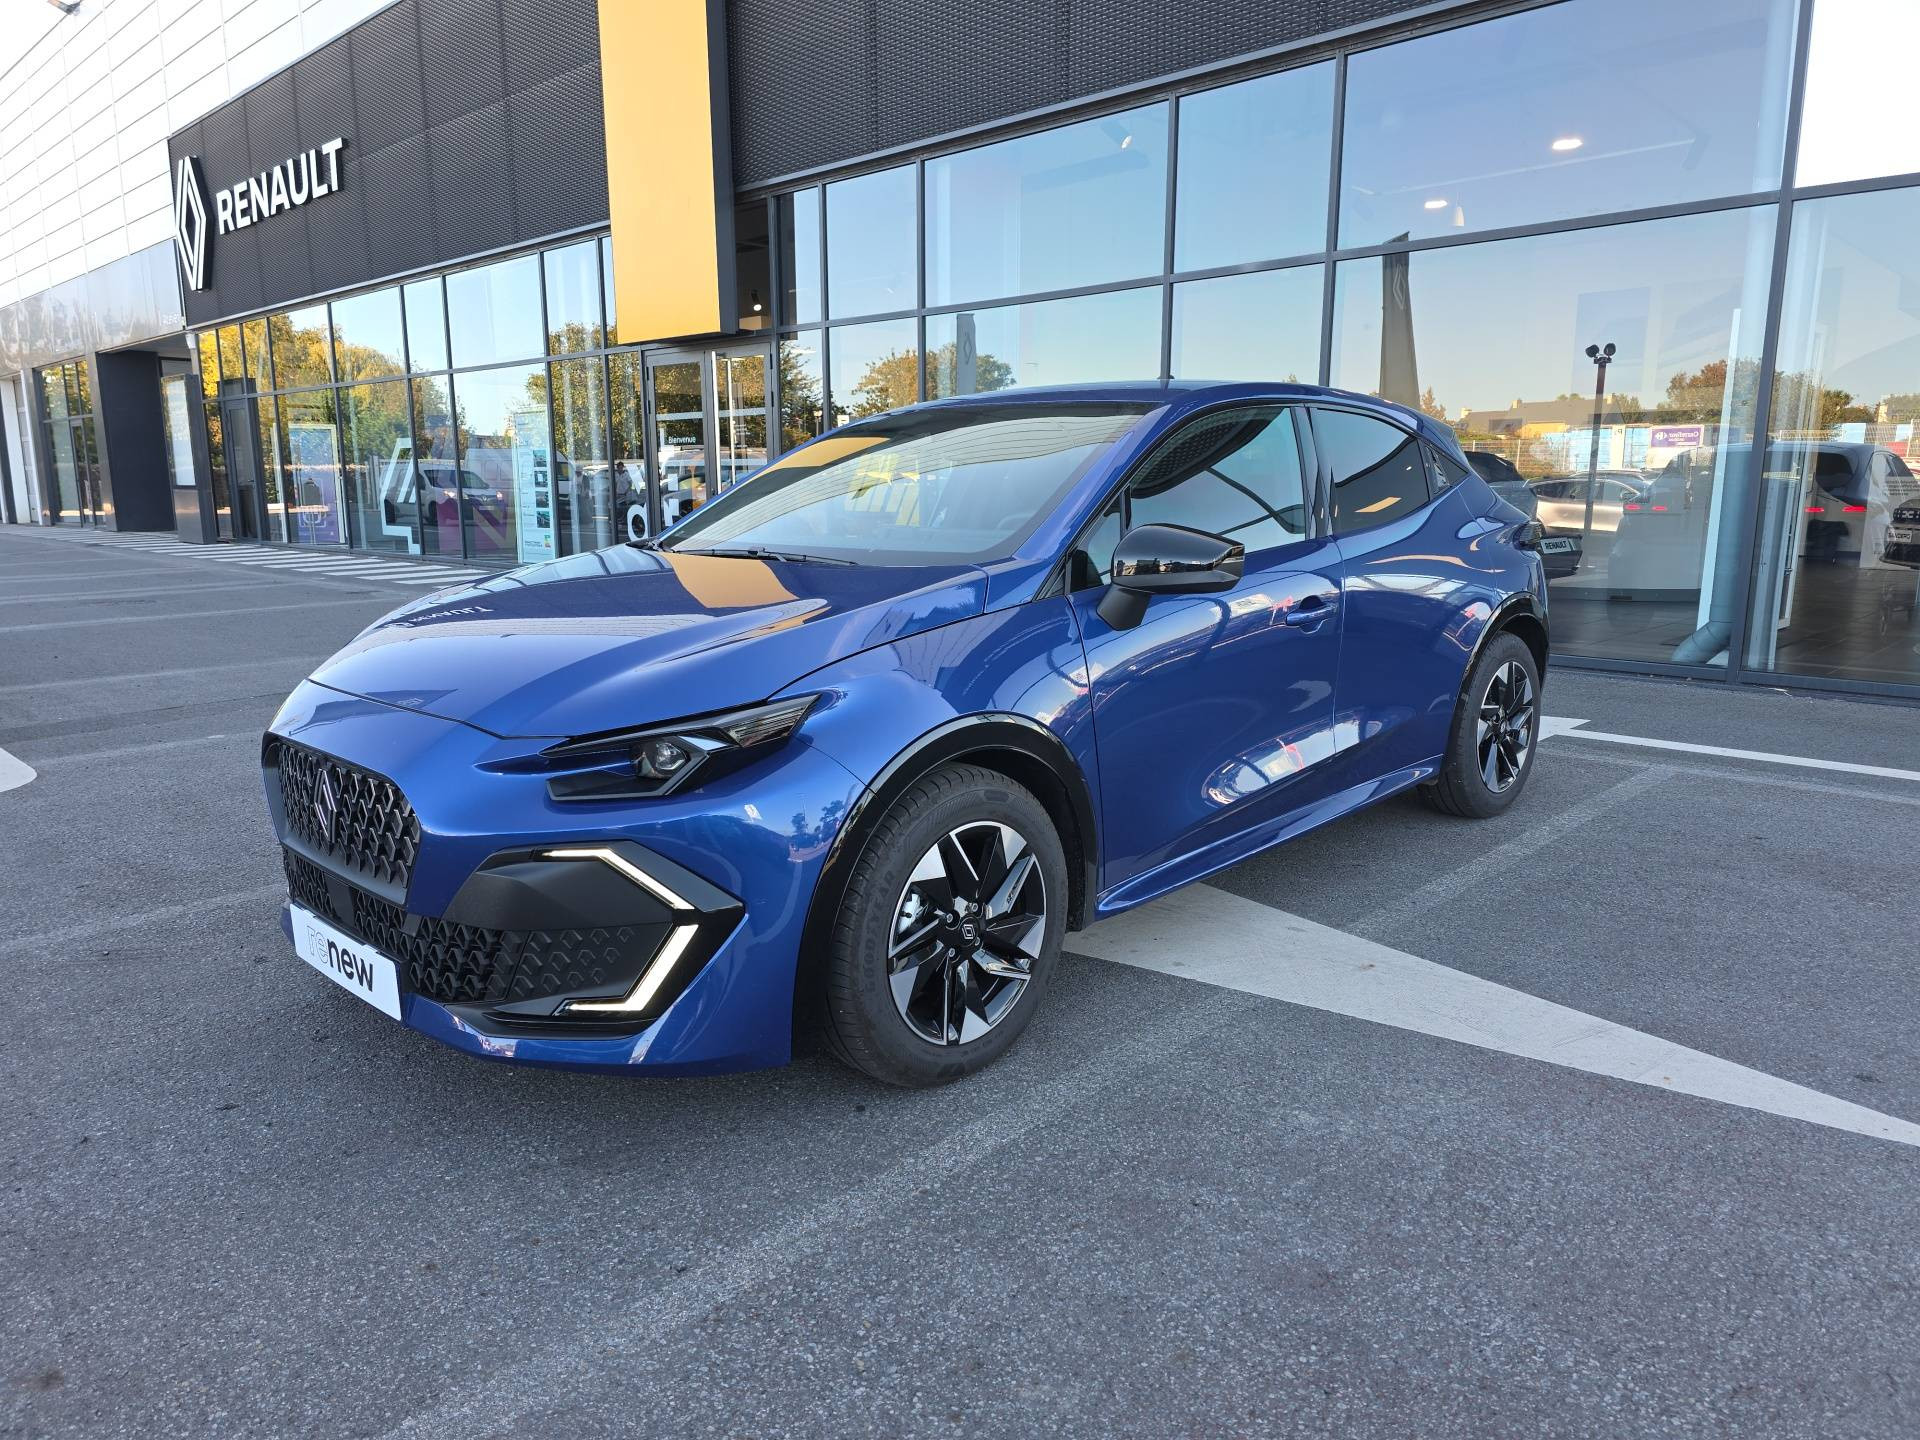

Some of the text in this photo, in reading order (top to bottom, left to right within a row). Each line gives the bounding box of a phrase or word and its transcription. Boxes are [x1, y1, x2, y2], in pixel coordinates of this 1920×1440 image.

[215, 136, 343, 236] RENAULT
[668, 435, 697, 444] Bienvenue
[1544, 540, 1567, 550] RENAULT
[306, 925, 374, 993] renew
